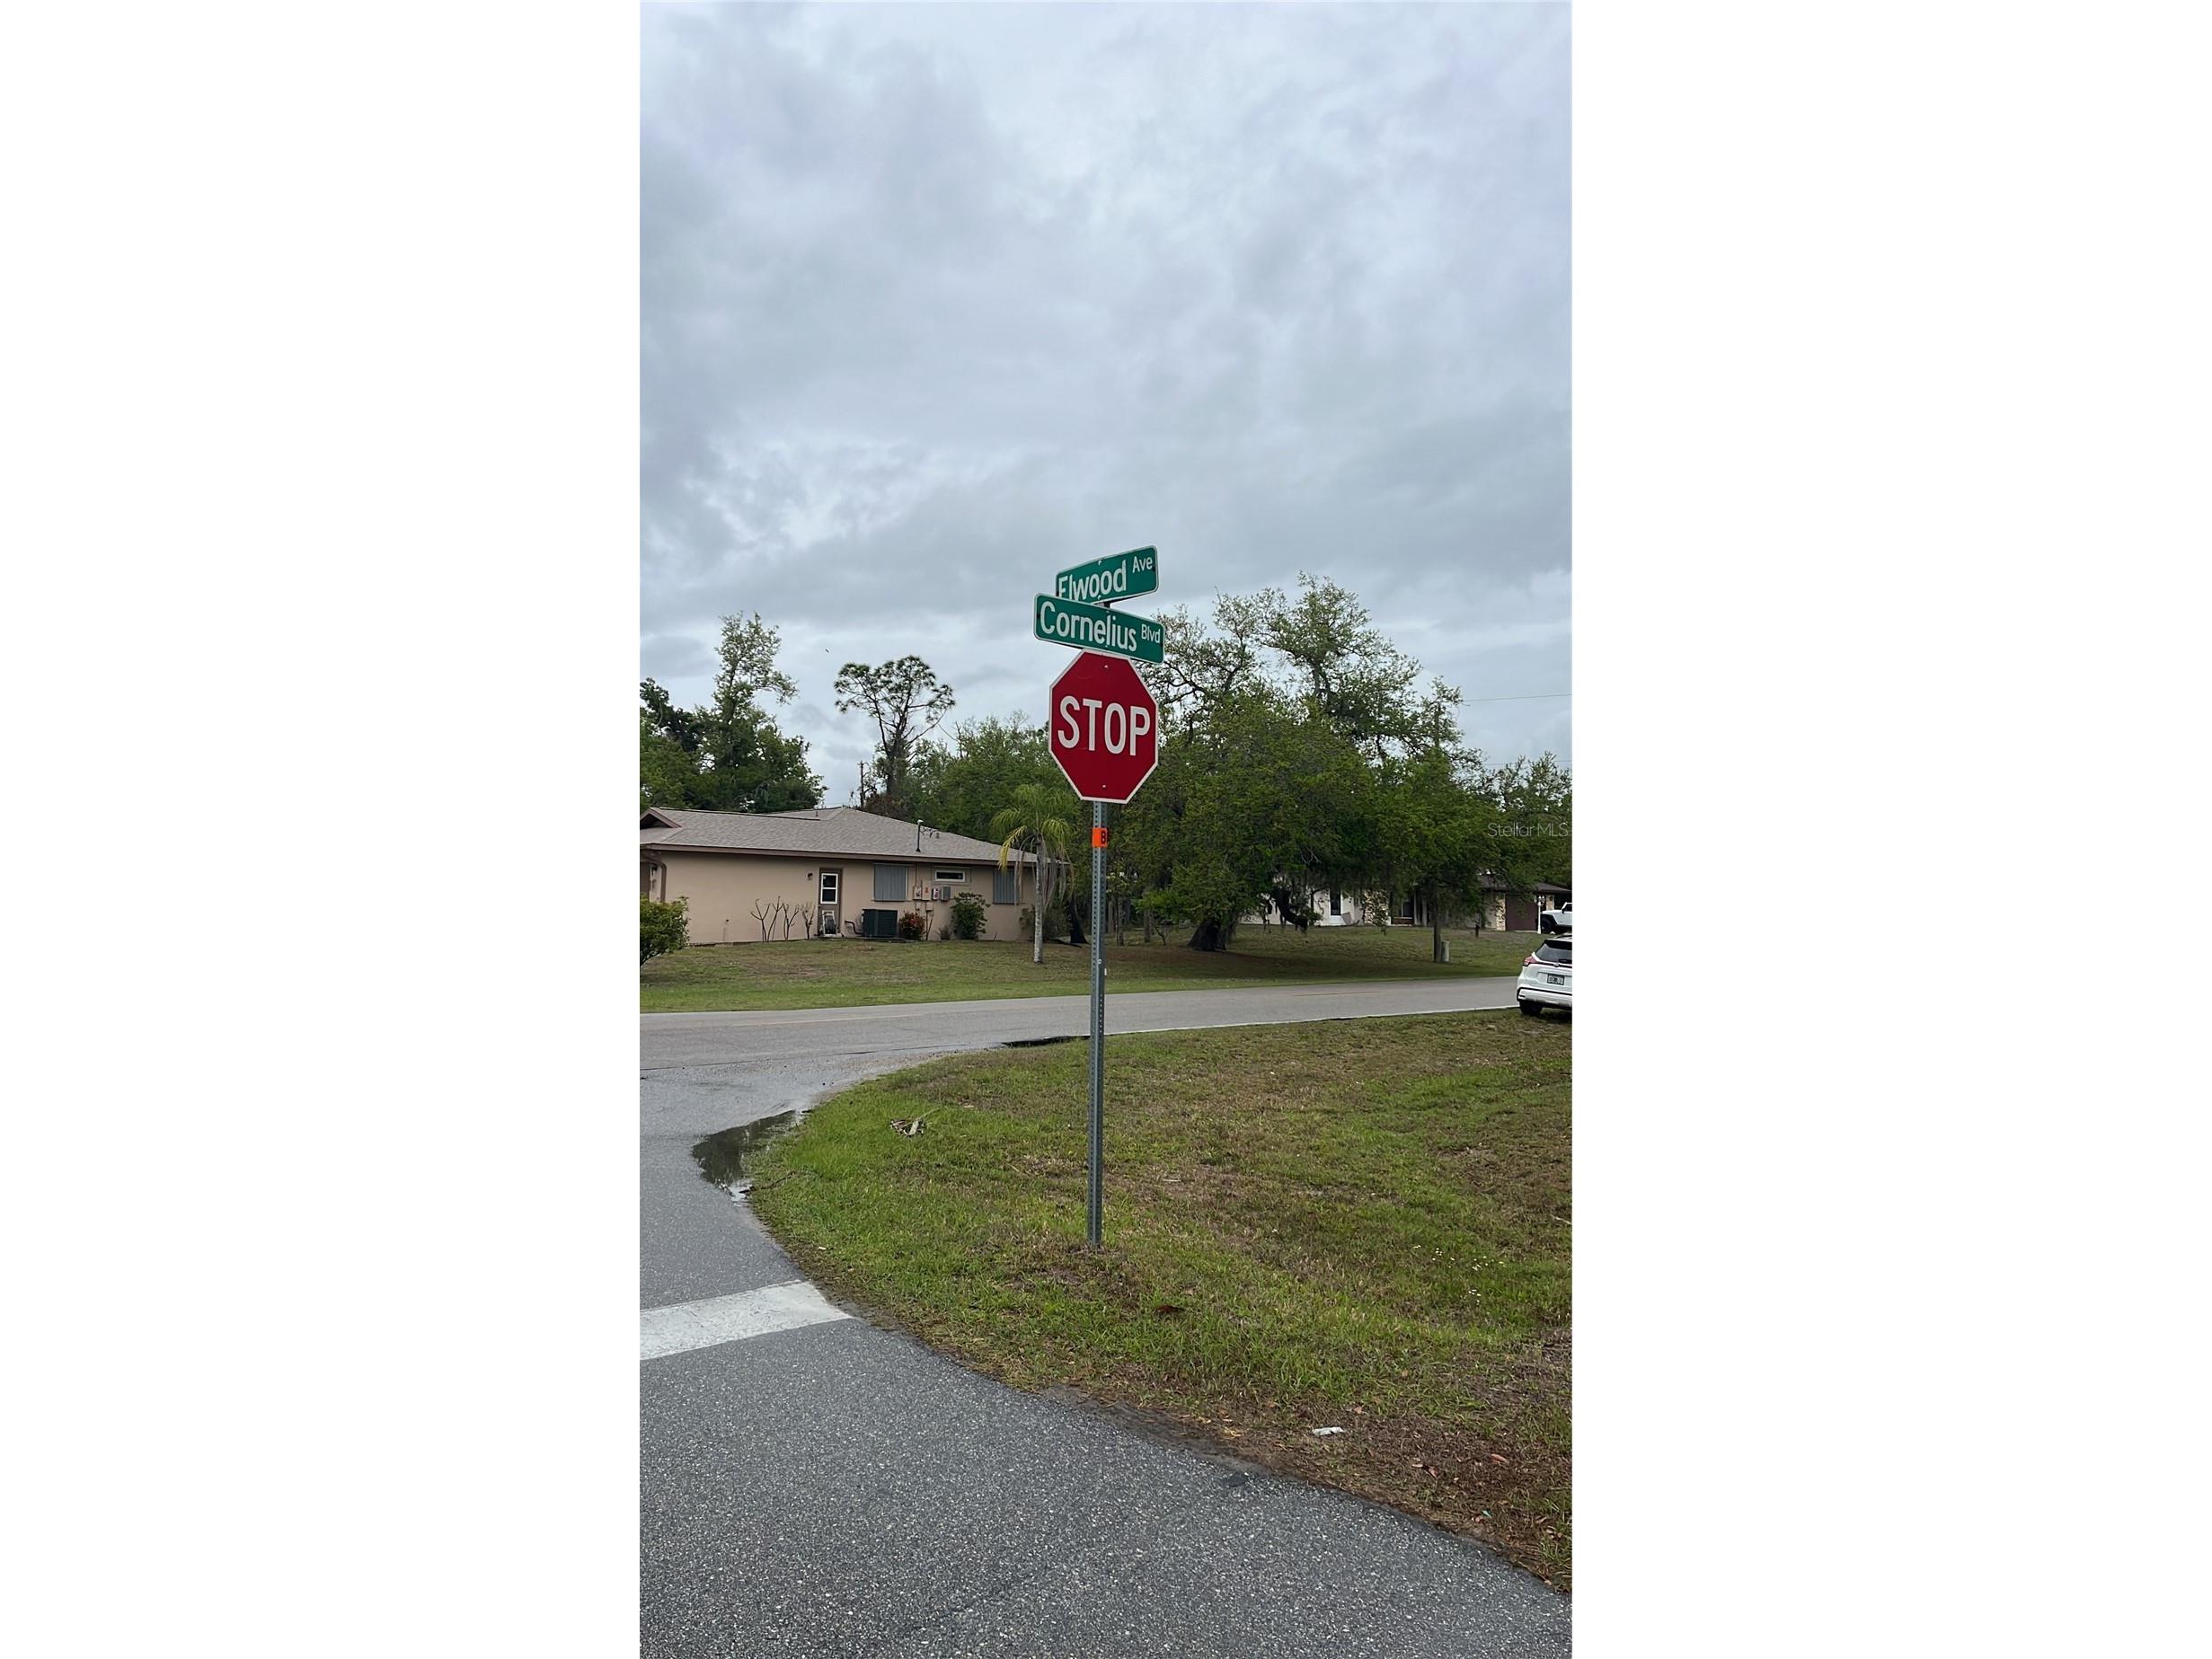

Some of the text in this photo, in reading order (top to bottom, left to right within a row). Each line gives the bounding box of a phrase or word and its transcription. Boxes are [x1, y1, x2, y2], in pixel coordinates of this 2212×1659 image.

[1058, 556, 1153, 602] Elwood Ave
[1040, 601, 1161, 652] Cornelius Blvd
[1057, 695, 1151, 756] STOP
